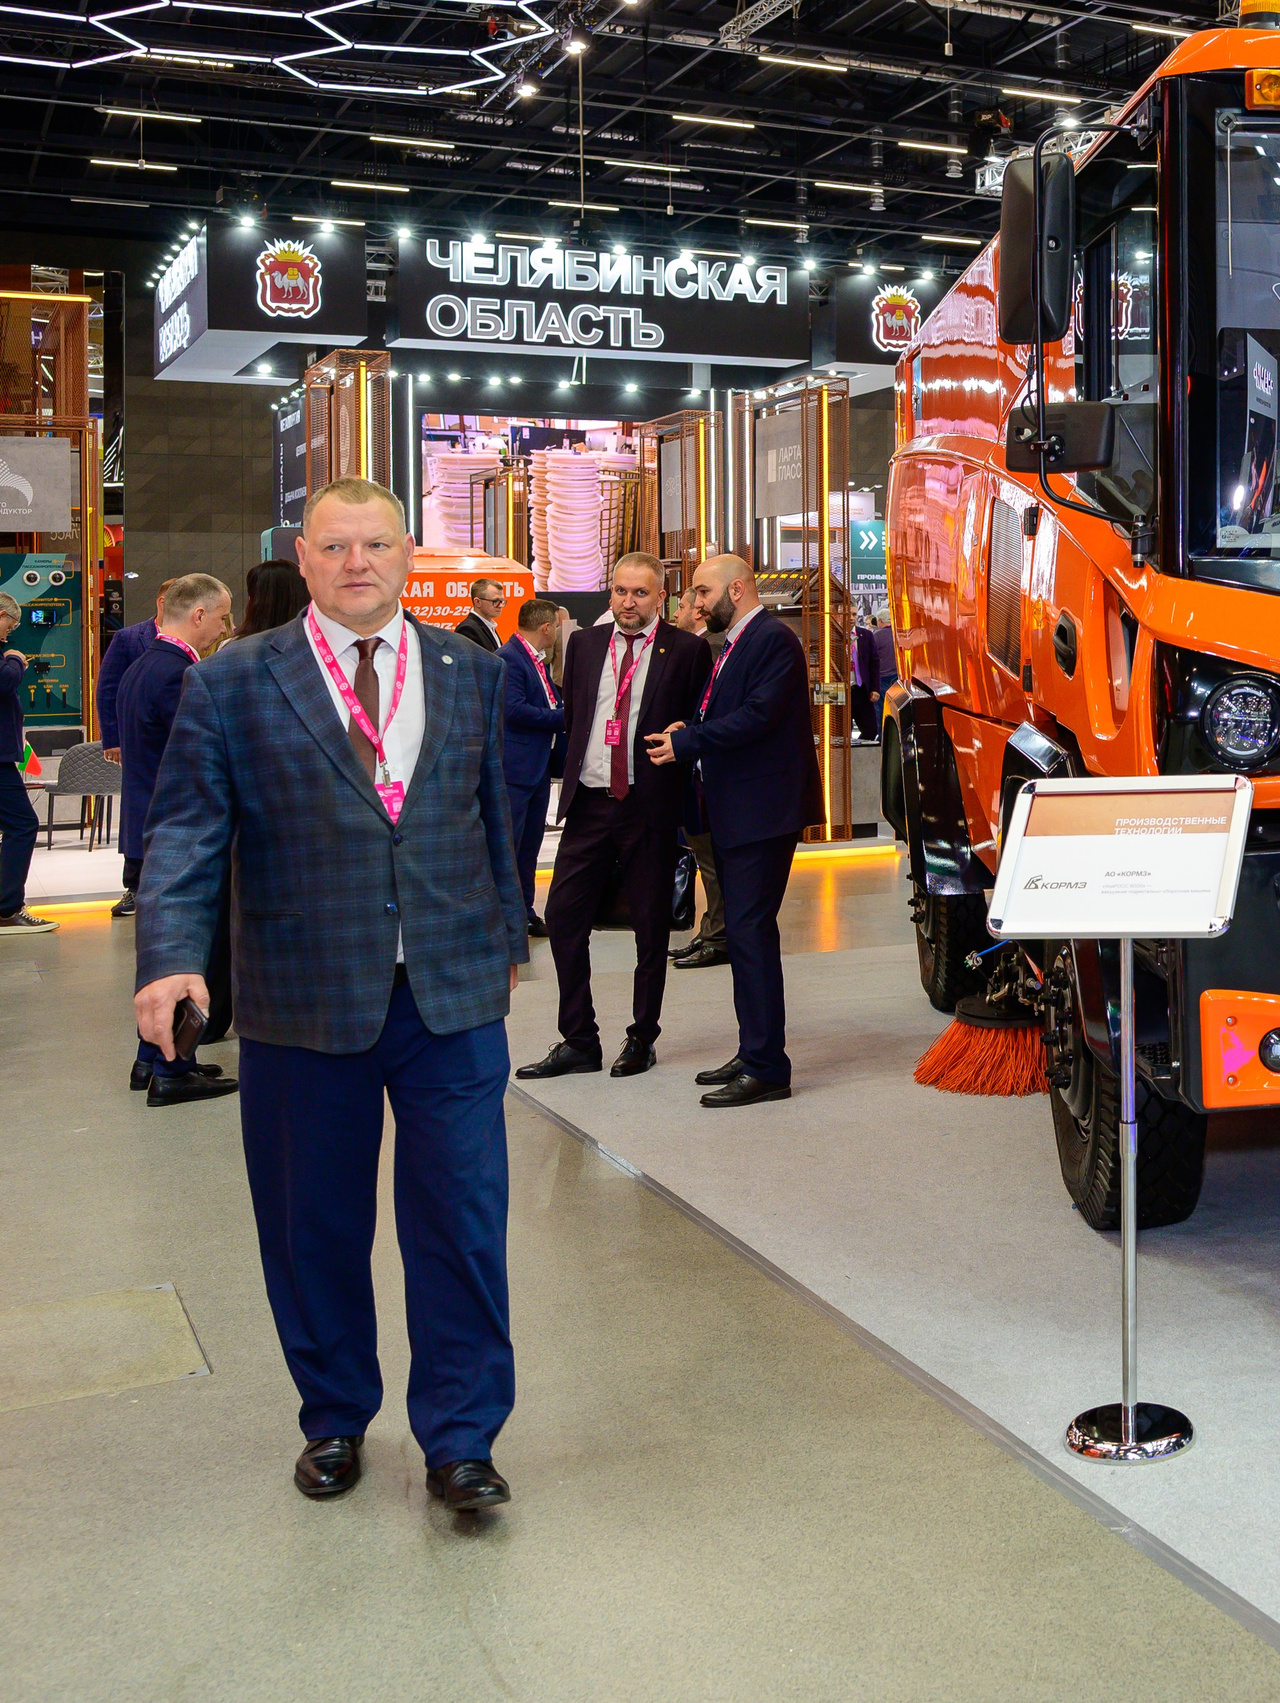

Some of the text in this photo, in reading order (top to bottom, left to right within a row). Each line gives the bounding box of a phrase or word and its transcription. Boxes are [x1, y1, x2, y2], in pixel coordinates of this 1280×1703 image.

[426, 239, 788, 305] ЧЕЛЯБИНСКАЯ
[425, 294, 665, 348] ОБЛАСТЬ
[778, 444, 802, 462] ЛАРТА
[778, 464, 802, 482] ГЛАСС
[446, 582, 524, 598] ОБТЬ
[1116, 816, 1227, 827] ПРОИЗВОДСТВЕННЫЕ
[1114, 827, 1182, 836] ТЕХНОЛОГИИ
